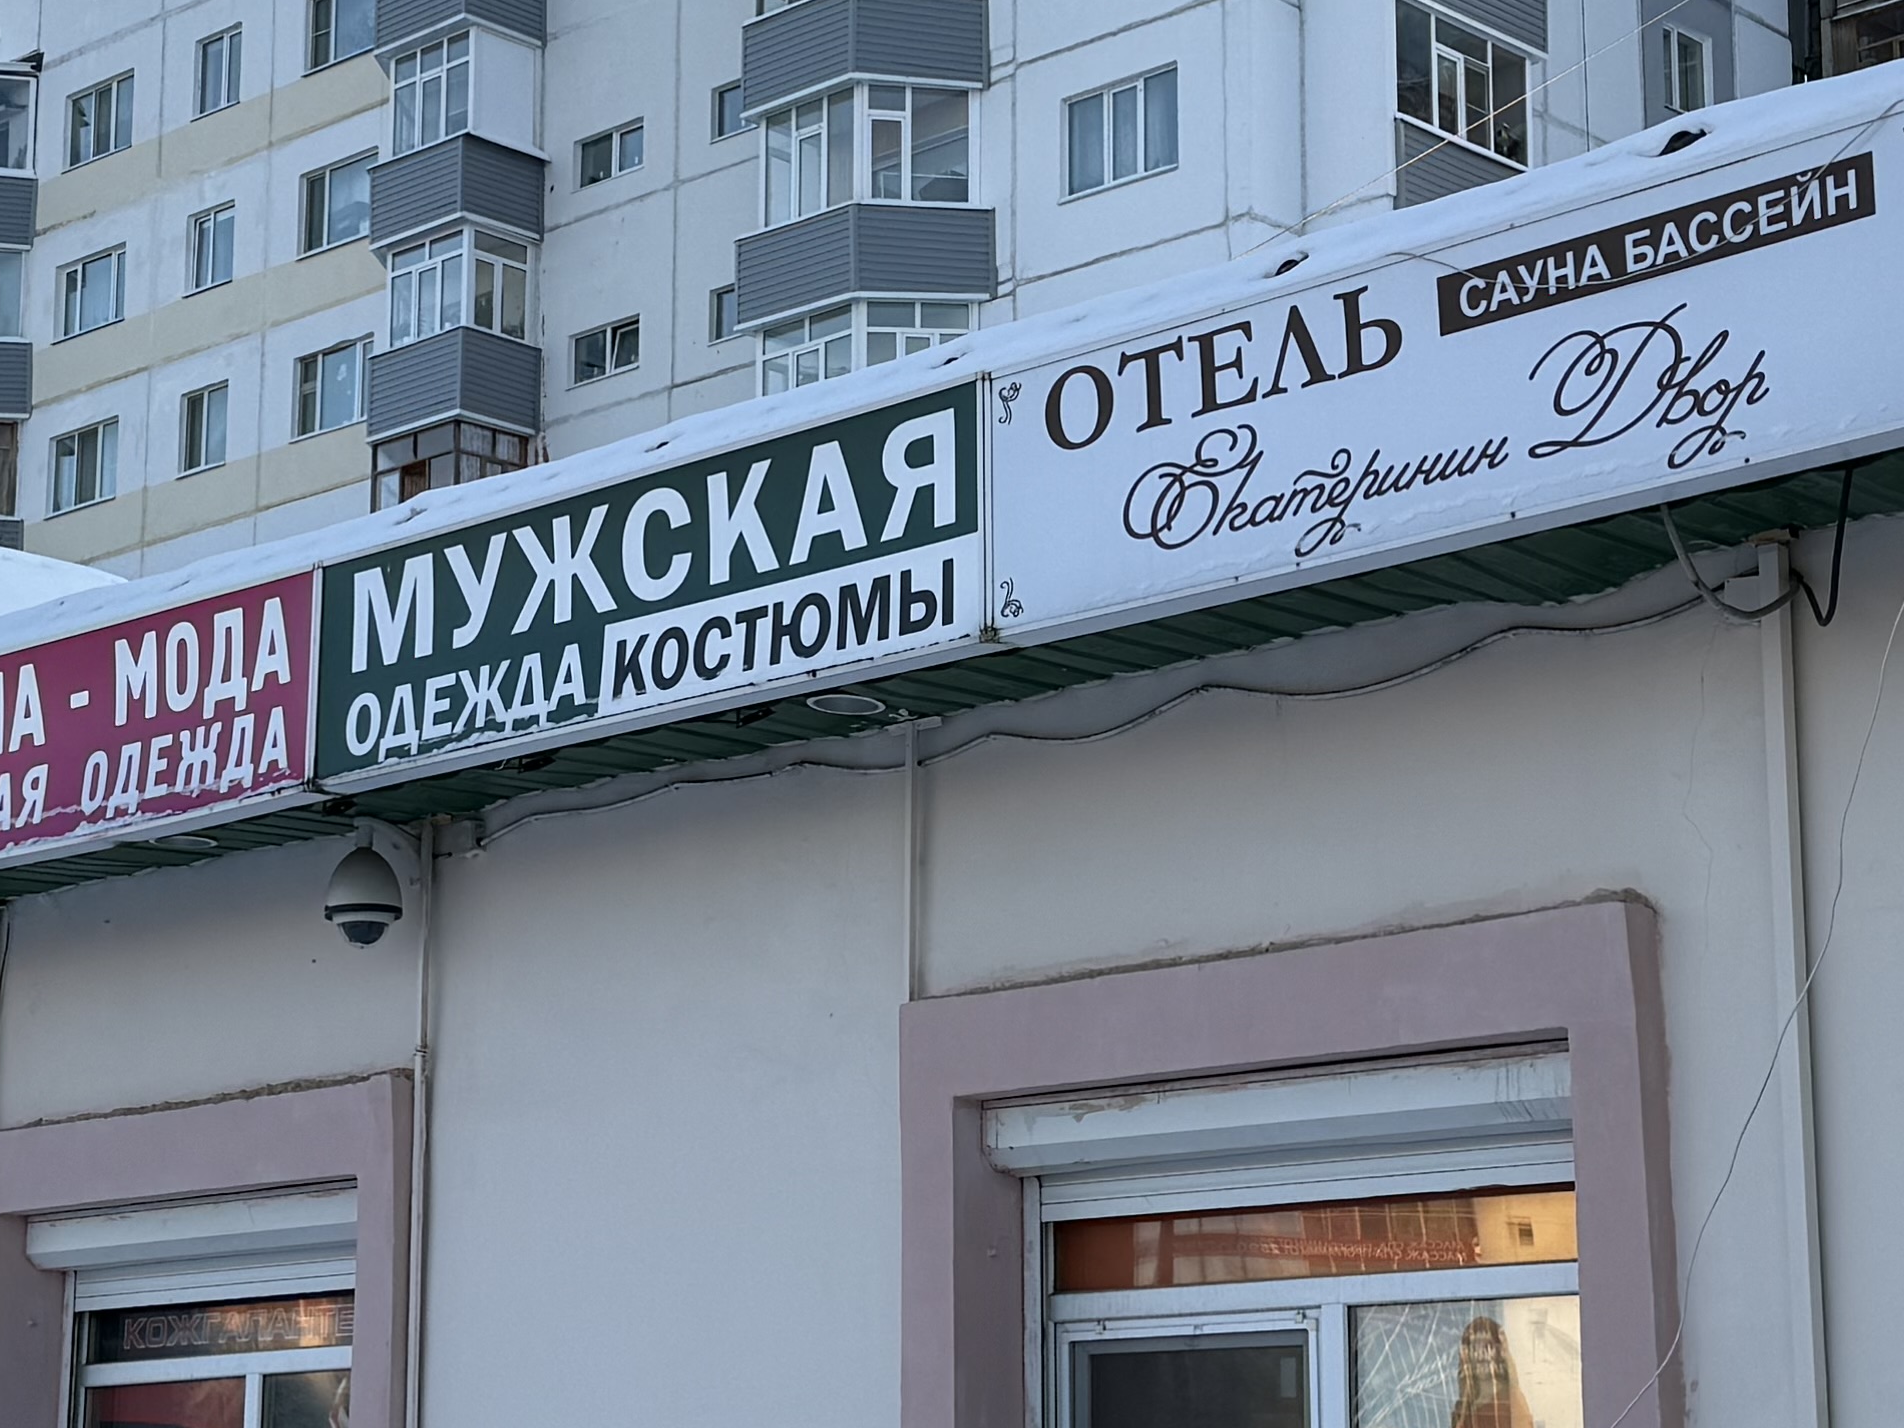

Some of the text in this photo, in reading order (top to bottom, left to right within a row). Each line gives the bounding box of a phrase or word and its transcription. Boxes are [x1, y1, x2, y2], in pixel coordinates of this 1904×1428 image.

[1457, 168, 1858, 317] САУНА БАССЕЙН
[1043, 285, 1403, 451] ОТЕЛЬ
[1122, 302, 1768, 558] Екатеринин Двор
[352, 407, 957, 674] МУЖСКАЯ
[114, 597, 290, 727] МОДА
[345, 558, 954, 761] ОДЕЖДА КОСТЮМЫ
[80, 706, 288, 818] ОДЕЖДА
